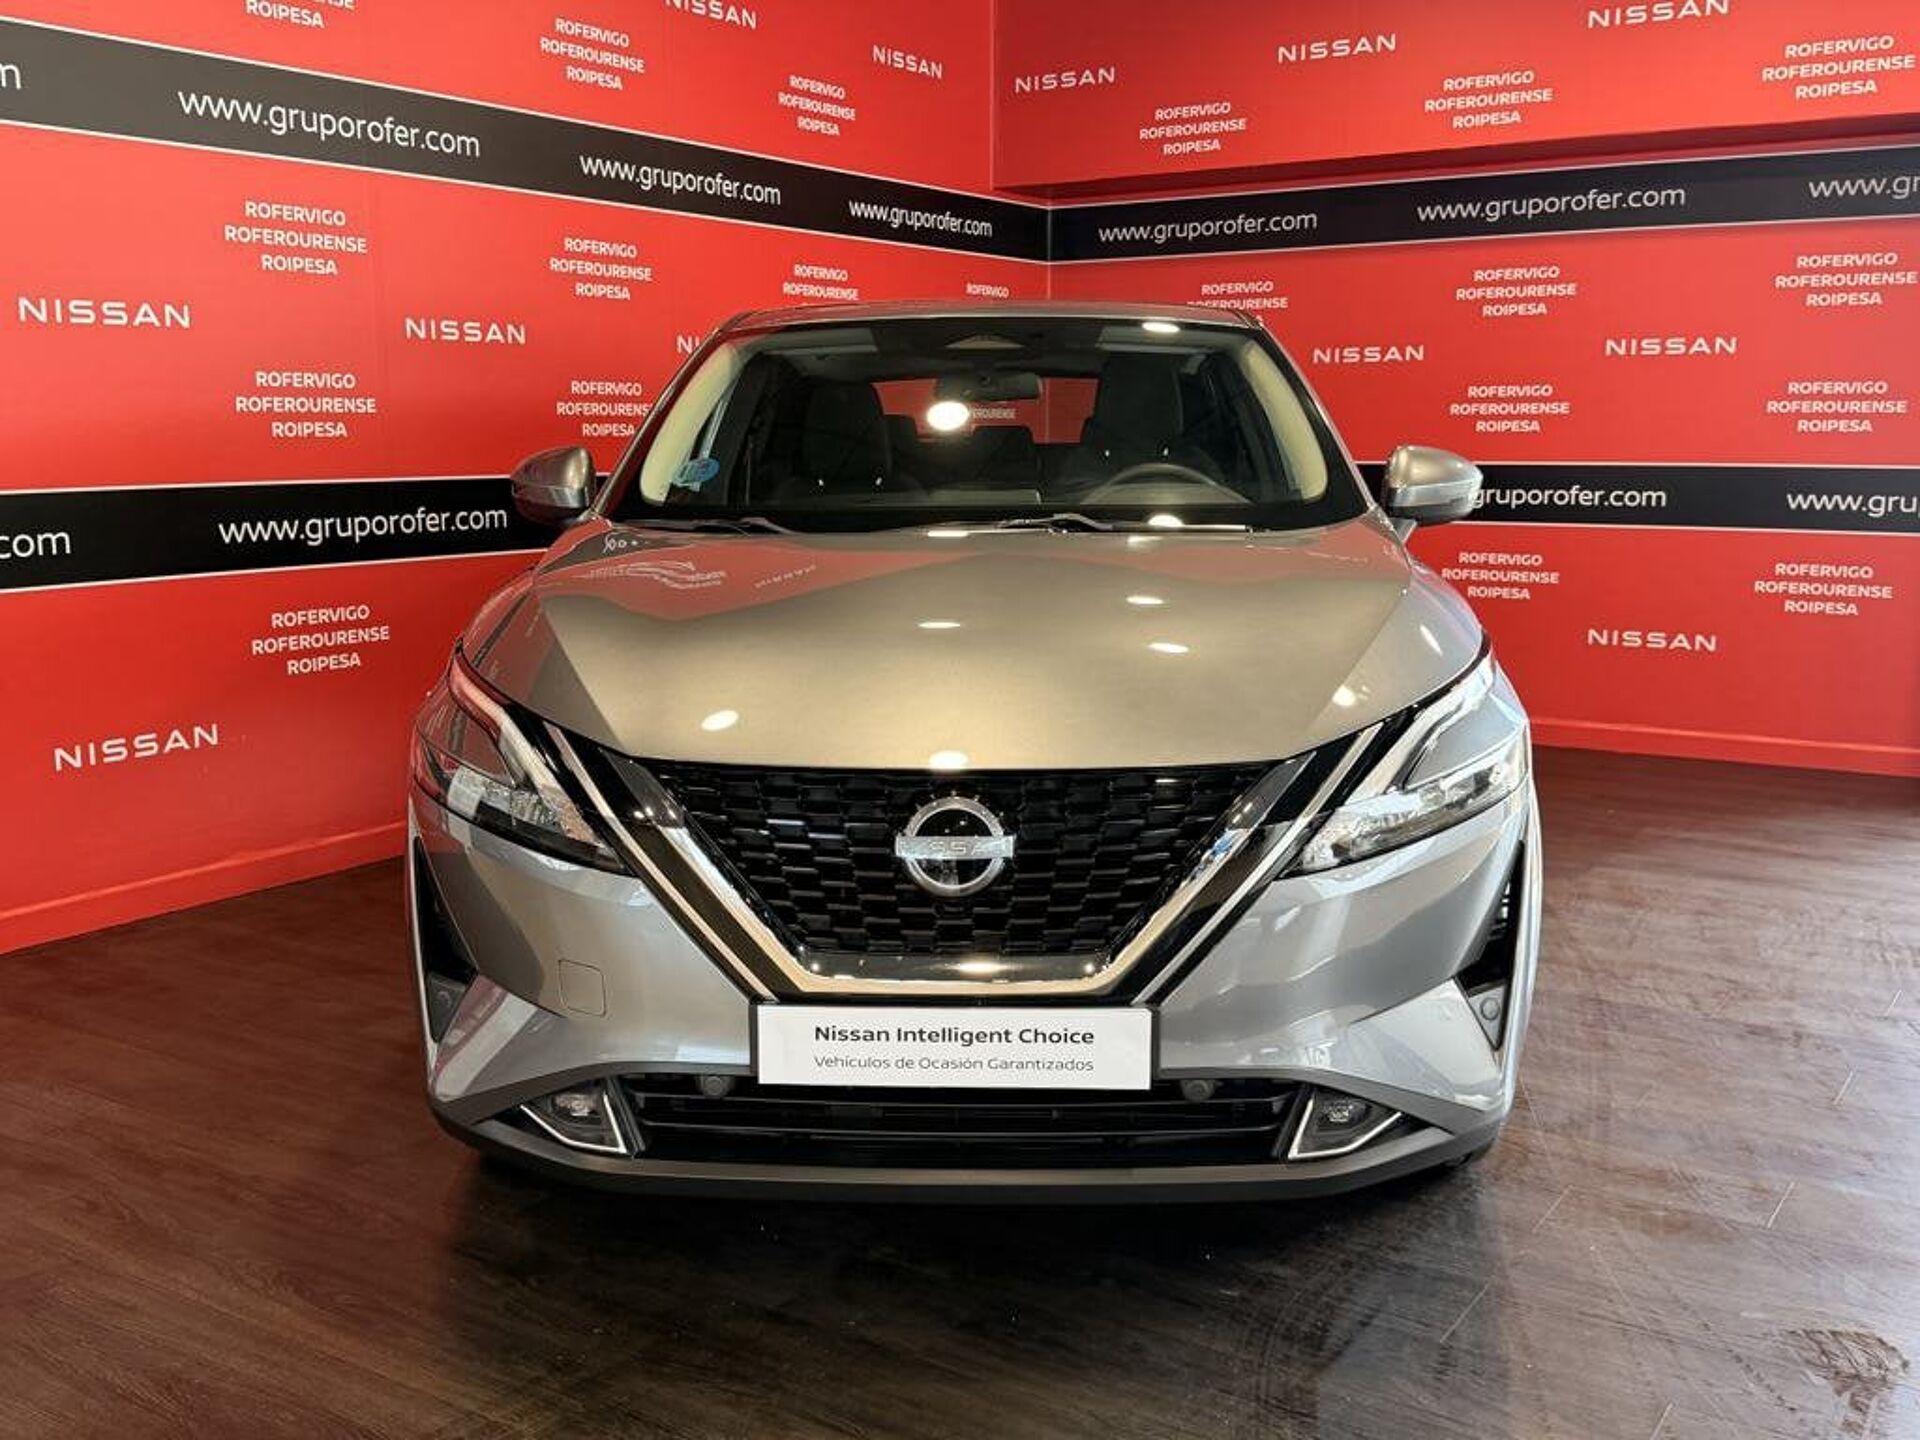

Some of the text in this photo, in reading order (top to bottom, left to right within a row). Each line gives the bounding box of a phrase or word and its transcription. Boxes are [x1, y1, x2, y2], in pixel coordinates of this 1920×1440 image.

[247, 0, 324, 27] ROIPESA
[1589, 0, 1728, 27] NISSAN
[556, 19, 629, 47] ROFERVIGO
[540, 37, 644, 72] ROFEROURENSE
[1279, 34, 1395, 62] NISSAN
[1785, 36, 1894, 58] ROFERVIGO
[873, 45, 942, 78] NISSAN
[1762, 55, 1915, 80] ROFEROURENSE
[567, 66, 622, 89] ROIPESA
[790, 75, 845, 99] ROFERVIGO
[1016, 67, 1114, 92] NISSAN
[1444, 71, 1534, 90] ROFERVIGO
[1796, 80, 1877, 98] ROIPESA
[779, 92, 855, 120] ROFEROURENSE
[1425, 89, 1552, 111] ROFEROURENSE
[1155, 102, 1231, 120] ROFERVIGO
[1453, 111, 1521, 128] ROIPESA
[178, 91, 480, 157] www.gruporofer.com
[798, 116, 839, 135] ROIPESA
[1140, 119, 1246, 139] ROFEROURENSE
[1164, 139, 1220, 154] ROIPESA
[580, 155, 781, 205] www.gruporofer.com
[246, 201, 345, 225] ROFERVIGO
[1417, 186, 1686, 223] www.gruporofer.com
[848, 200, 993, 237] www.gruporofer.com
[1099, 211, 1318, 245] www.gruporofer.com
[225, 225, 366, 252] ROFEROURENSE
[564, 238, 637, 258] ROFERVIGO
[261, 255, 337, 274] ROIPESA
[550, 258, 651, 281] ROFEROURENSE
[1797, 253, 1898, 268] ROFERVIGO
[794, 264, 848, 281] ROFERVIGO
[1474, 266, 1560, 281] ROFERVIGO
[1776, 272, 1917, 287] ROFEROURENSE
[576, 283, 630, 300] ROIPESA
[783, 282, 859, 300] ROFEROURENSE
[1202, 281, 1273, 295] ROFERVIGO
[1457, 283, 1576, 300] ROFEROURENSE
[1806, 292, 1882, 306] ROIPESA
[19, 297, 189, 327] NISSAN
[1483, 303, 1547, 316] ROIPESA
[406, 318, 525, 343] NISSAN
[1314, 345, 1423, 363] NISSAN
[1606, 337, 1736, 355] NISSAN
[256, 371, 355, 388] ROFERVIGO
[571, 381, 641, 396] ROFERVIGO
[1788, 381, 1888, 394] ROFERVIGO
[1468, 385, 1552, 397] ROFERVIGO
[236, 397, 375, 412] ROFEROURENSE
[1450, 402, 1569, 415] ROFEROURENSE
[1767, 401, 1907, 413] ROFEROURENSE
[272, 422, 347, 437] ROIPESA
[583, 423, 635, 437] ROIPESA
[1476, 420, 1540, 432] ROIPESA
[1798, 420, 1872, 432] ROIPESA
[1786, 493, 1920, 518] www.gru
[218, 505, 508, 547] www.gruporofer.com
[1459, 552, 1542, 566] ROFERVIGO
[1442, 568, 1559, 583] ROFEROURENSE
[1775, 563, 1873, 578] ROFERVIGO
[1467, 586, 1530, 600] ROIPESA
[1755, 581, 1892, 598] ROFEROURENSE
[272, 605, 370, 628] ROFERVIGO
[1785, 600, 1858, 615] ROIPESA
[252, 626, 389, 655] ROFEROURENSE
[1588, 629, 1716, 651] NISSAN
[287, 653, 360, 675] ROIPESA
[55, 724, 217, 771] NISSAN
[815, 1026, 1095, 1047] Nissan Intelligent Choice
[815, 1054, 1095, 1071] Vehículos de Ocasión Garantizados
